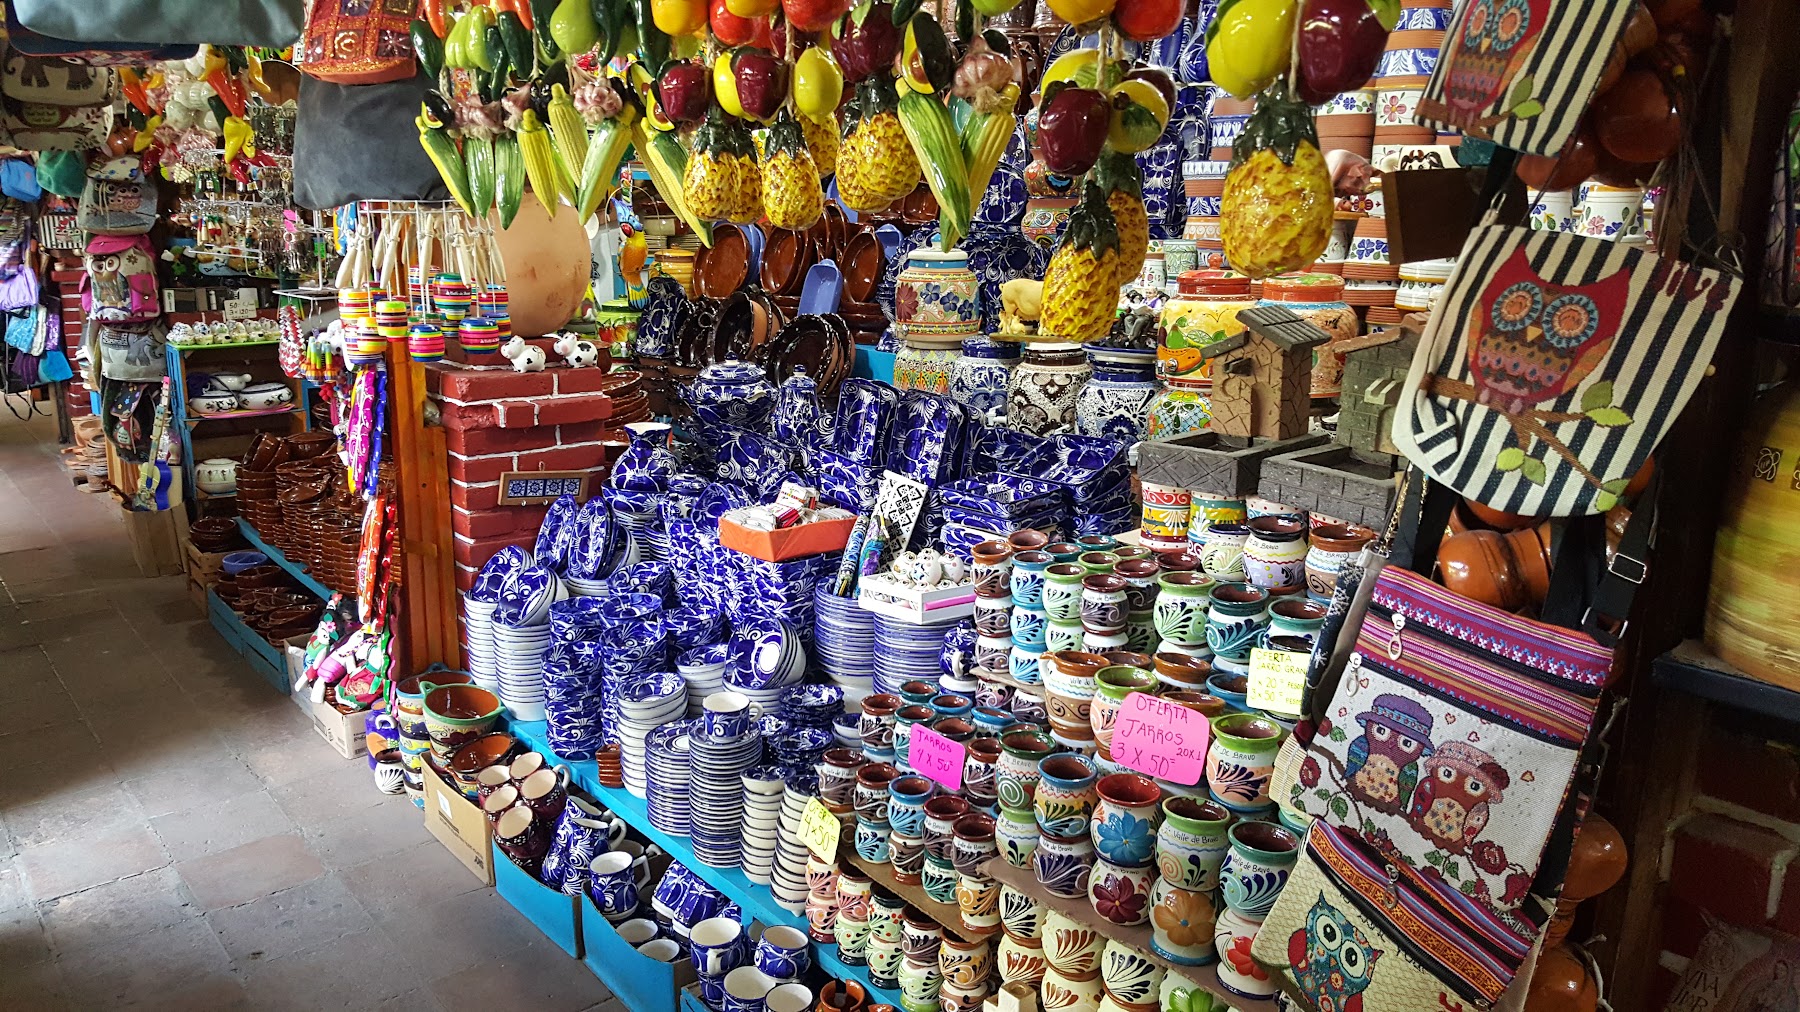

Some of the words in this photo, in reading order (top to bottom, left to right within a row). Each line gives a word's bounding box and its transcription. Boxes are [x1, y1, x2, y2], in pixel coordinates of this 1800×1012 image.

[1256, 650, 1292, 662] OFERTA
[1284, 665, 1306, 676] GRAN
[1136, 695, 1188, 724] OFERTA
[1121, 718, 1184, 746] JARROS
[1111, 742, 1126, 760] 3
[1219, 748, 1230, 757] DE
[1231, 751, 1256, 761] BRAVO
[1011, 758, 1032, 768] BRAVO
[809, 800, 834, 829] OFERTA
[1005, 819, 1019, 830] Bravo
[1173, 830, 1189, 842] Valle
[1190, 835, 1201, 844] de
[1201, 835, 1219, 844] Bravo
[1057, 844, 1074, 852] Bravo
[1231, 853, 1244, 868] Valle
[1243, 861, 1252, 870] de
